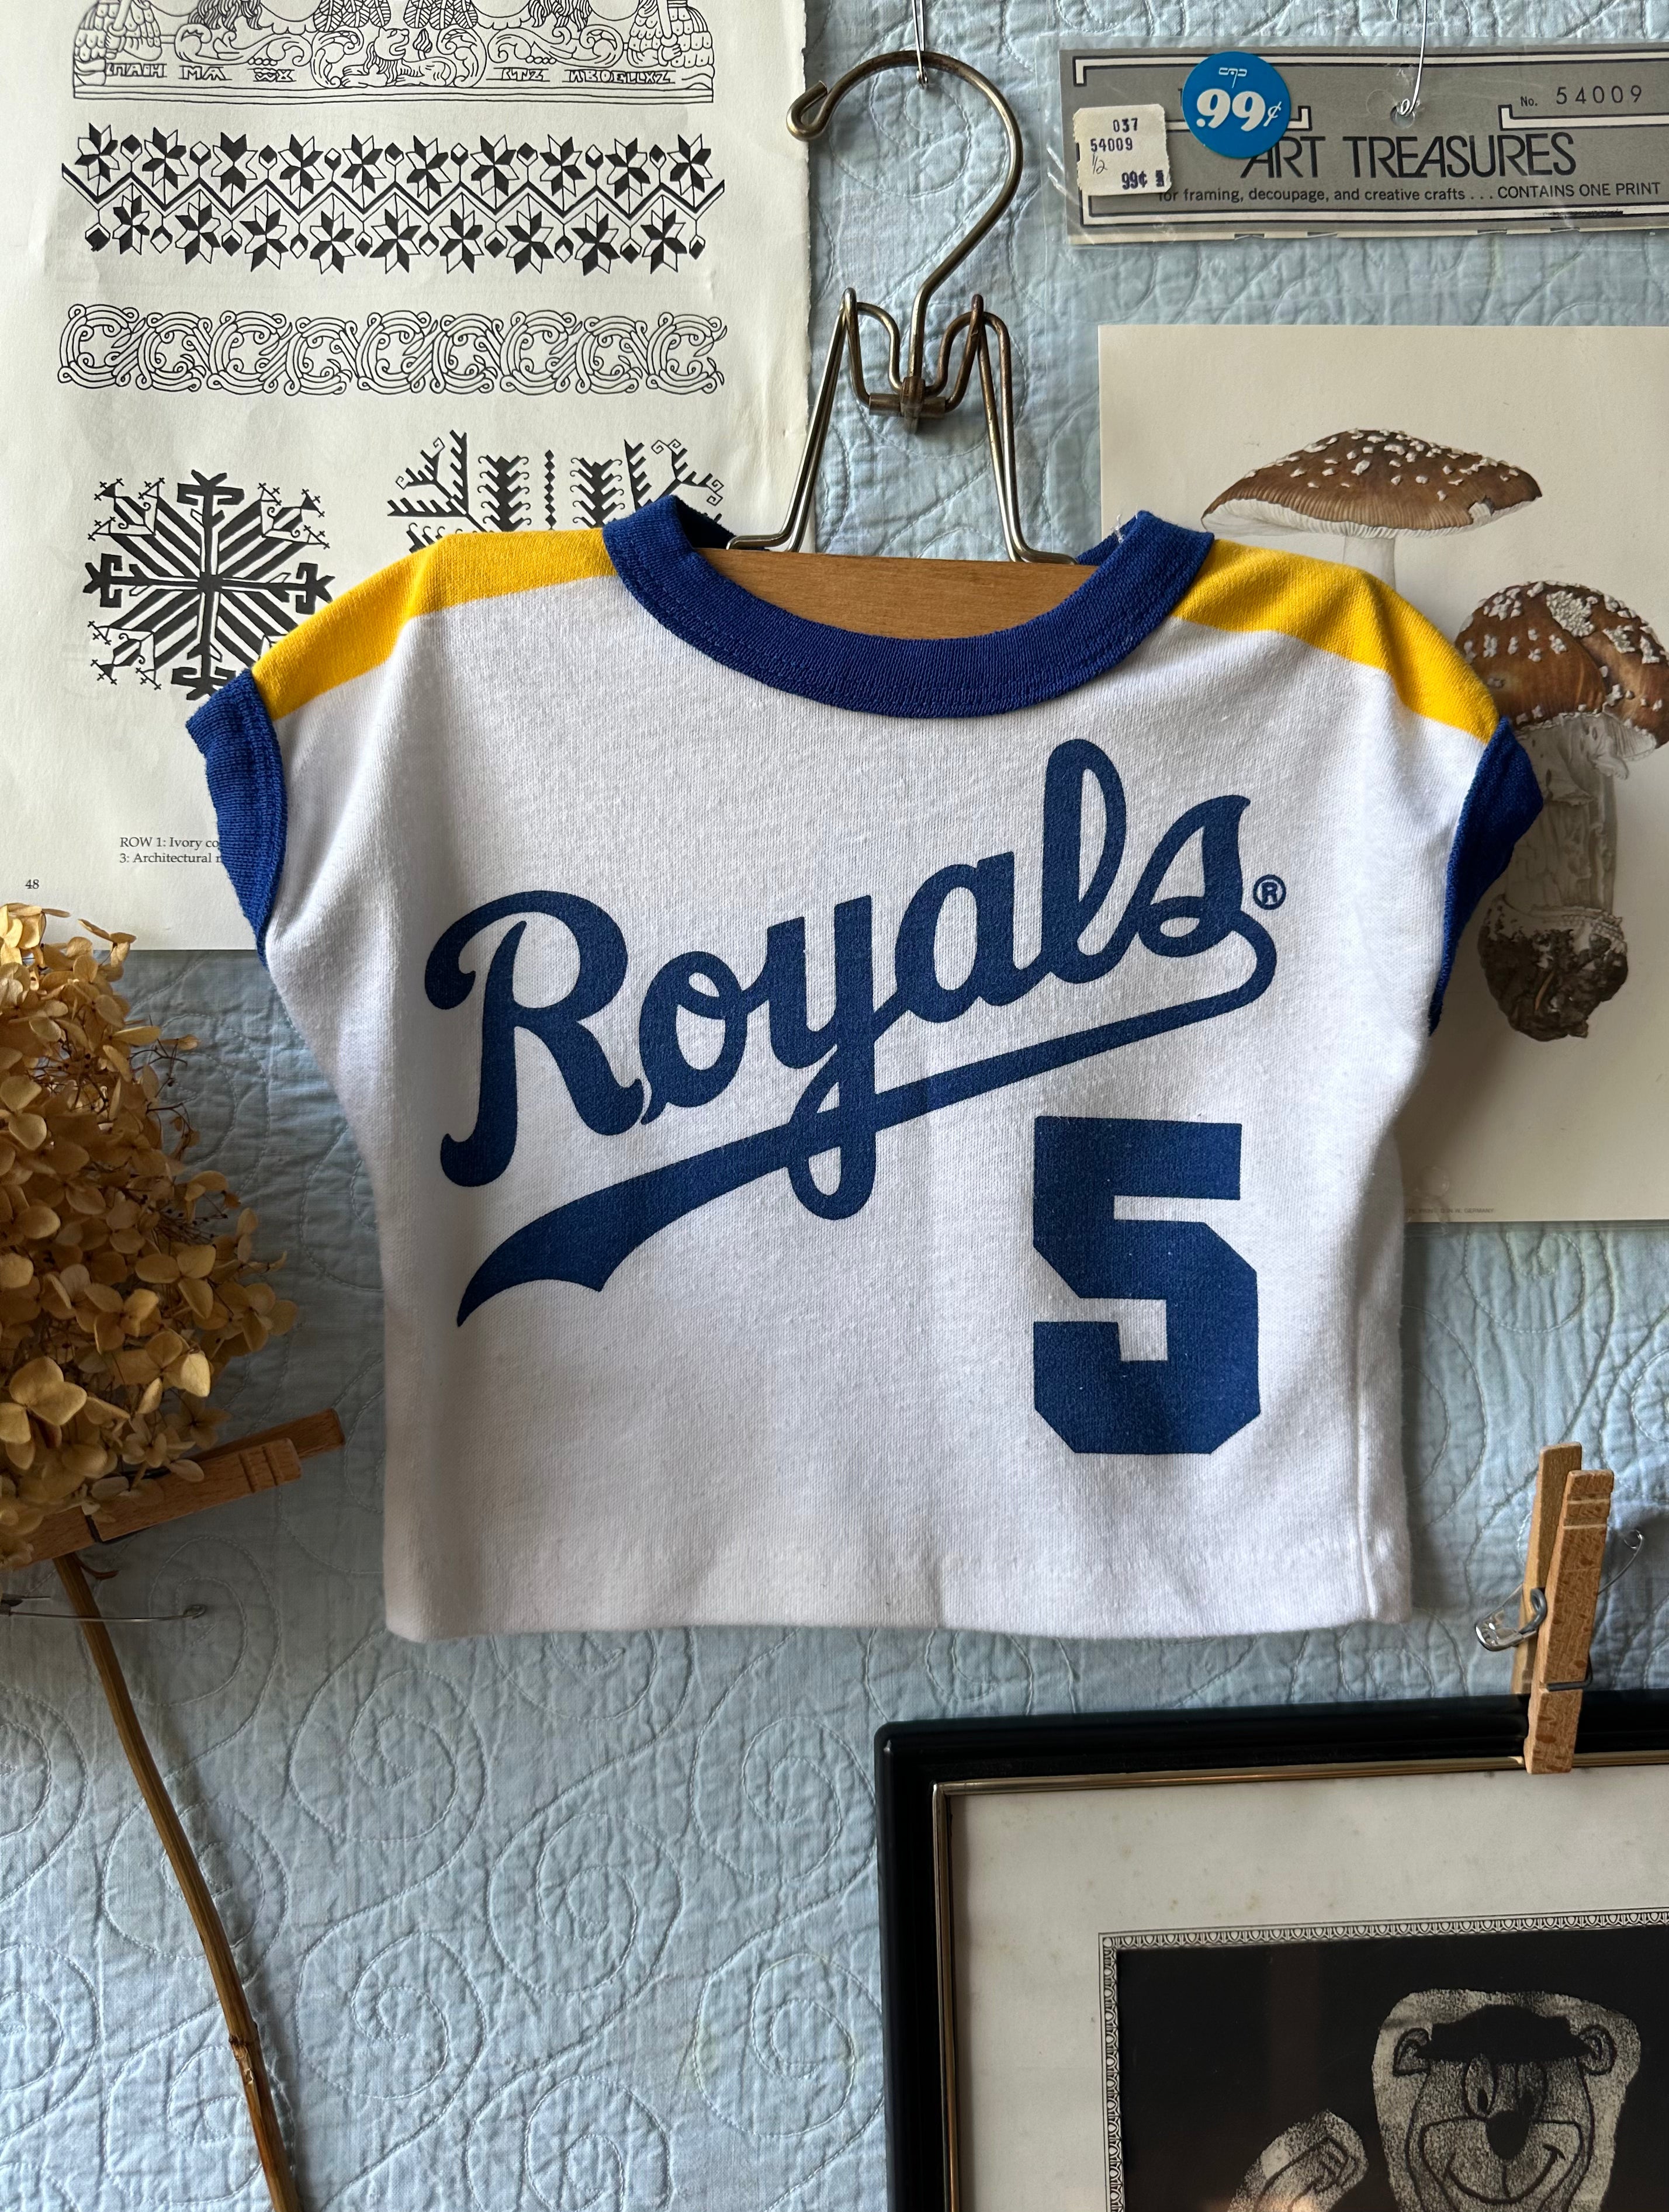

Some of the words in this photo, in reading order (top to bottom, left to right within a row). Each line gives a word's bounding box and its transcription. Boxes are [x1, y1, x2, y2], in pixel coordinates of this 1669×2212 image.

[1520, 96, 1538, 107] No.
[1556, 85, 1642, 105] 54009
[1113, 117, 1138, 133] 037
[1090, 137, 1133, 152] 54009
[1240, 136, 1326, 179] ART
[1343, 131, 1577, 179] TREASURES
[1121, 170, 1148, 190] 99¢
[1184, 188, 1244, 203] framing,
[1248, 188, 1328, 204] decoupage,
[1334, 188, 1360, 200] and
[1365, 188, 1420, 200] creative
[1424, 187, 1466, 200] crafts
[1497, 184, 1574, 199] CONTAINS
[1579, 183, 1611, 197] ONE
[1616, 182, 1661, 196] PRINT
[119, 837, 153, 847] ROW
[156, 837, 167, 847] 1:
[169, 837, 203, 851] Ivory
[119, 853, 130, 863] 3:
[133, 852, 212, 863] Architectural
[25, 879, 40, 889] 48
[425, 739, 1277, 1222] Royals
[1033, 1116, 1261, 1454] 5
